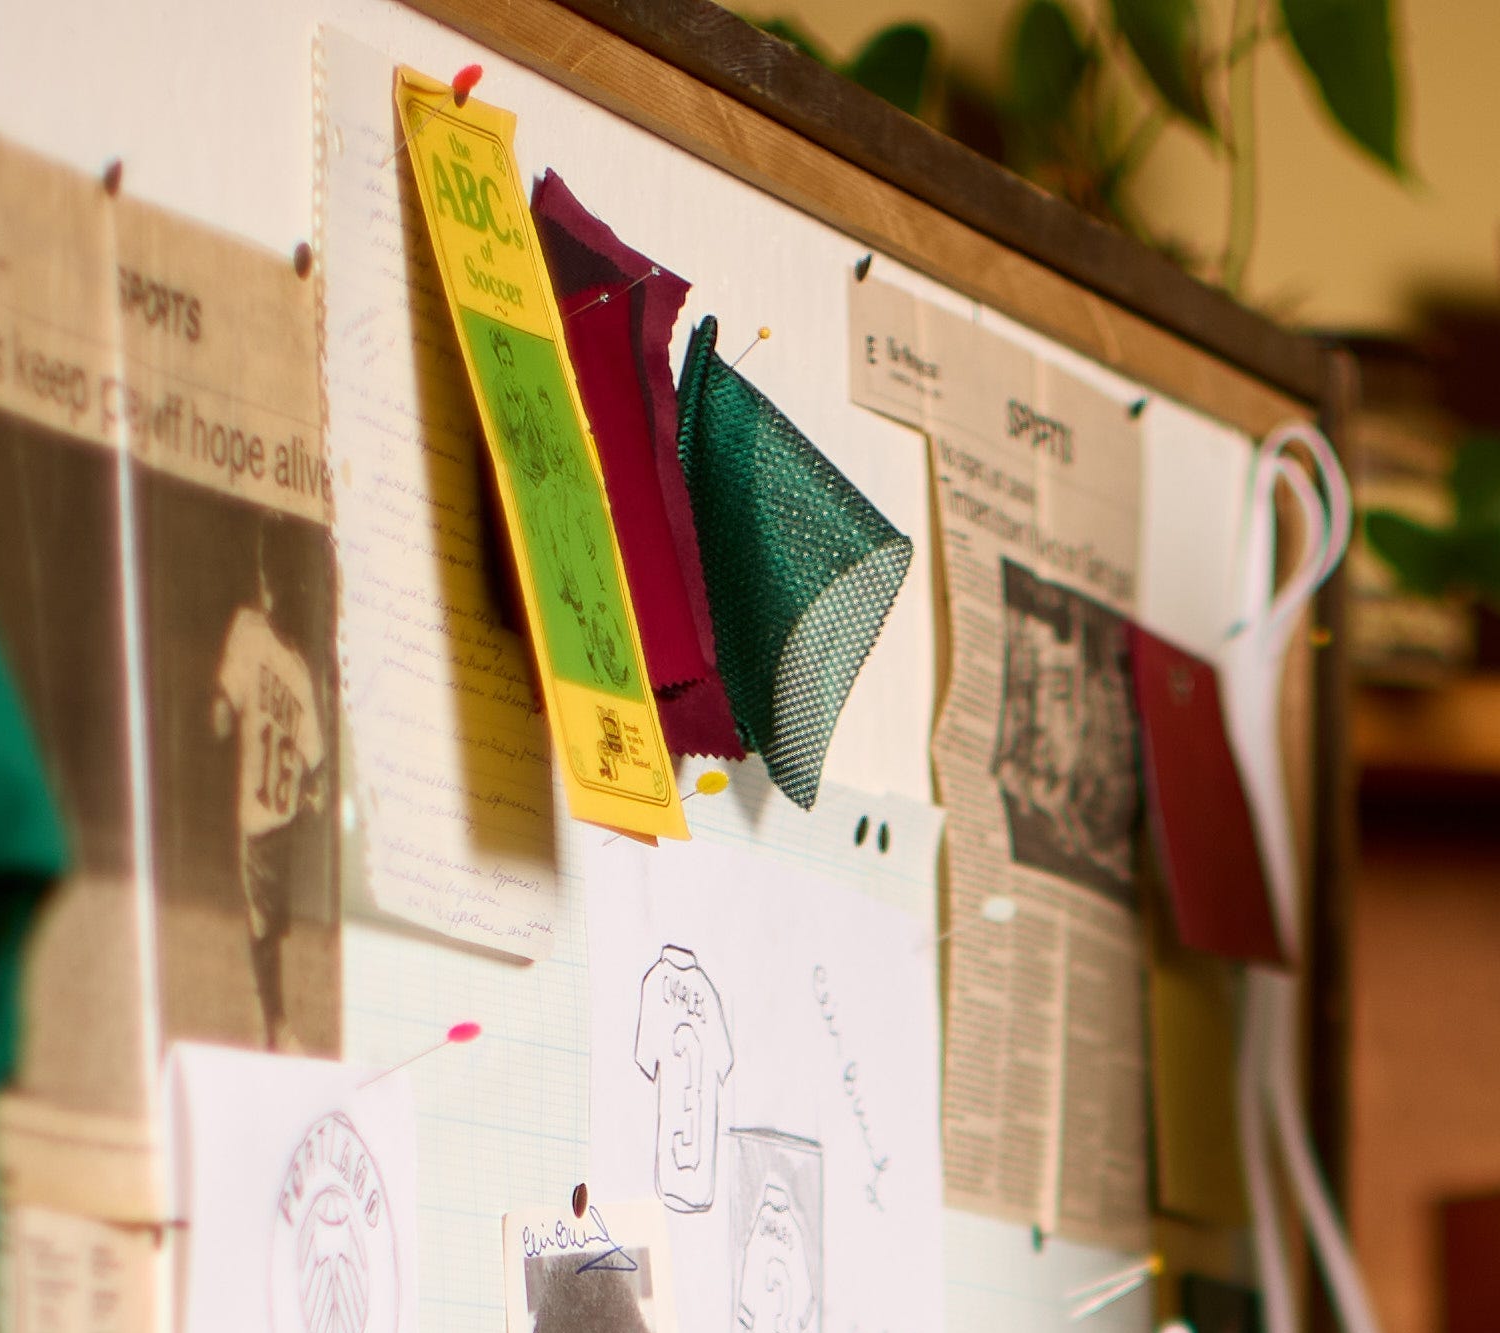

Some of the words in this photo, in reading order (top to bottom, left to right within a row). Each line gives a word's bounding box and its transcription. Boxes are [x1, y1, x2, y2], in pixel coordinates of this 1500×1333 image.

[448, 133, 470, 162] the
[432, 152, 524, 250] ABC's
[463, 256, 523, 307] Soccer
[190, 401, 266, 485] hope
[274, 434, 333, 505] alive
